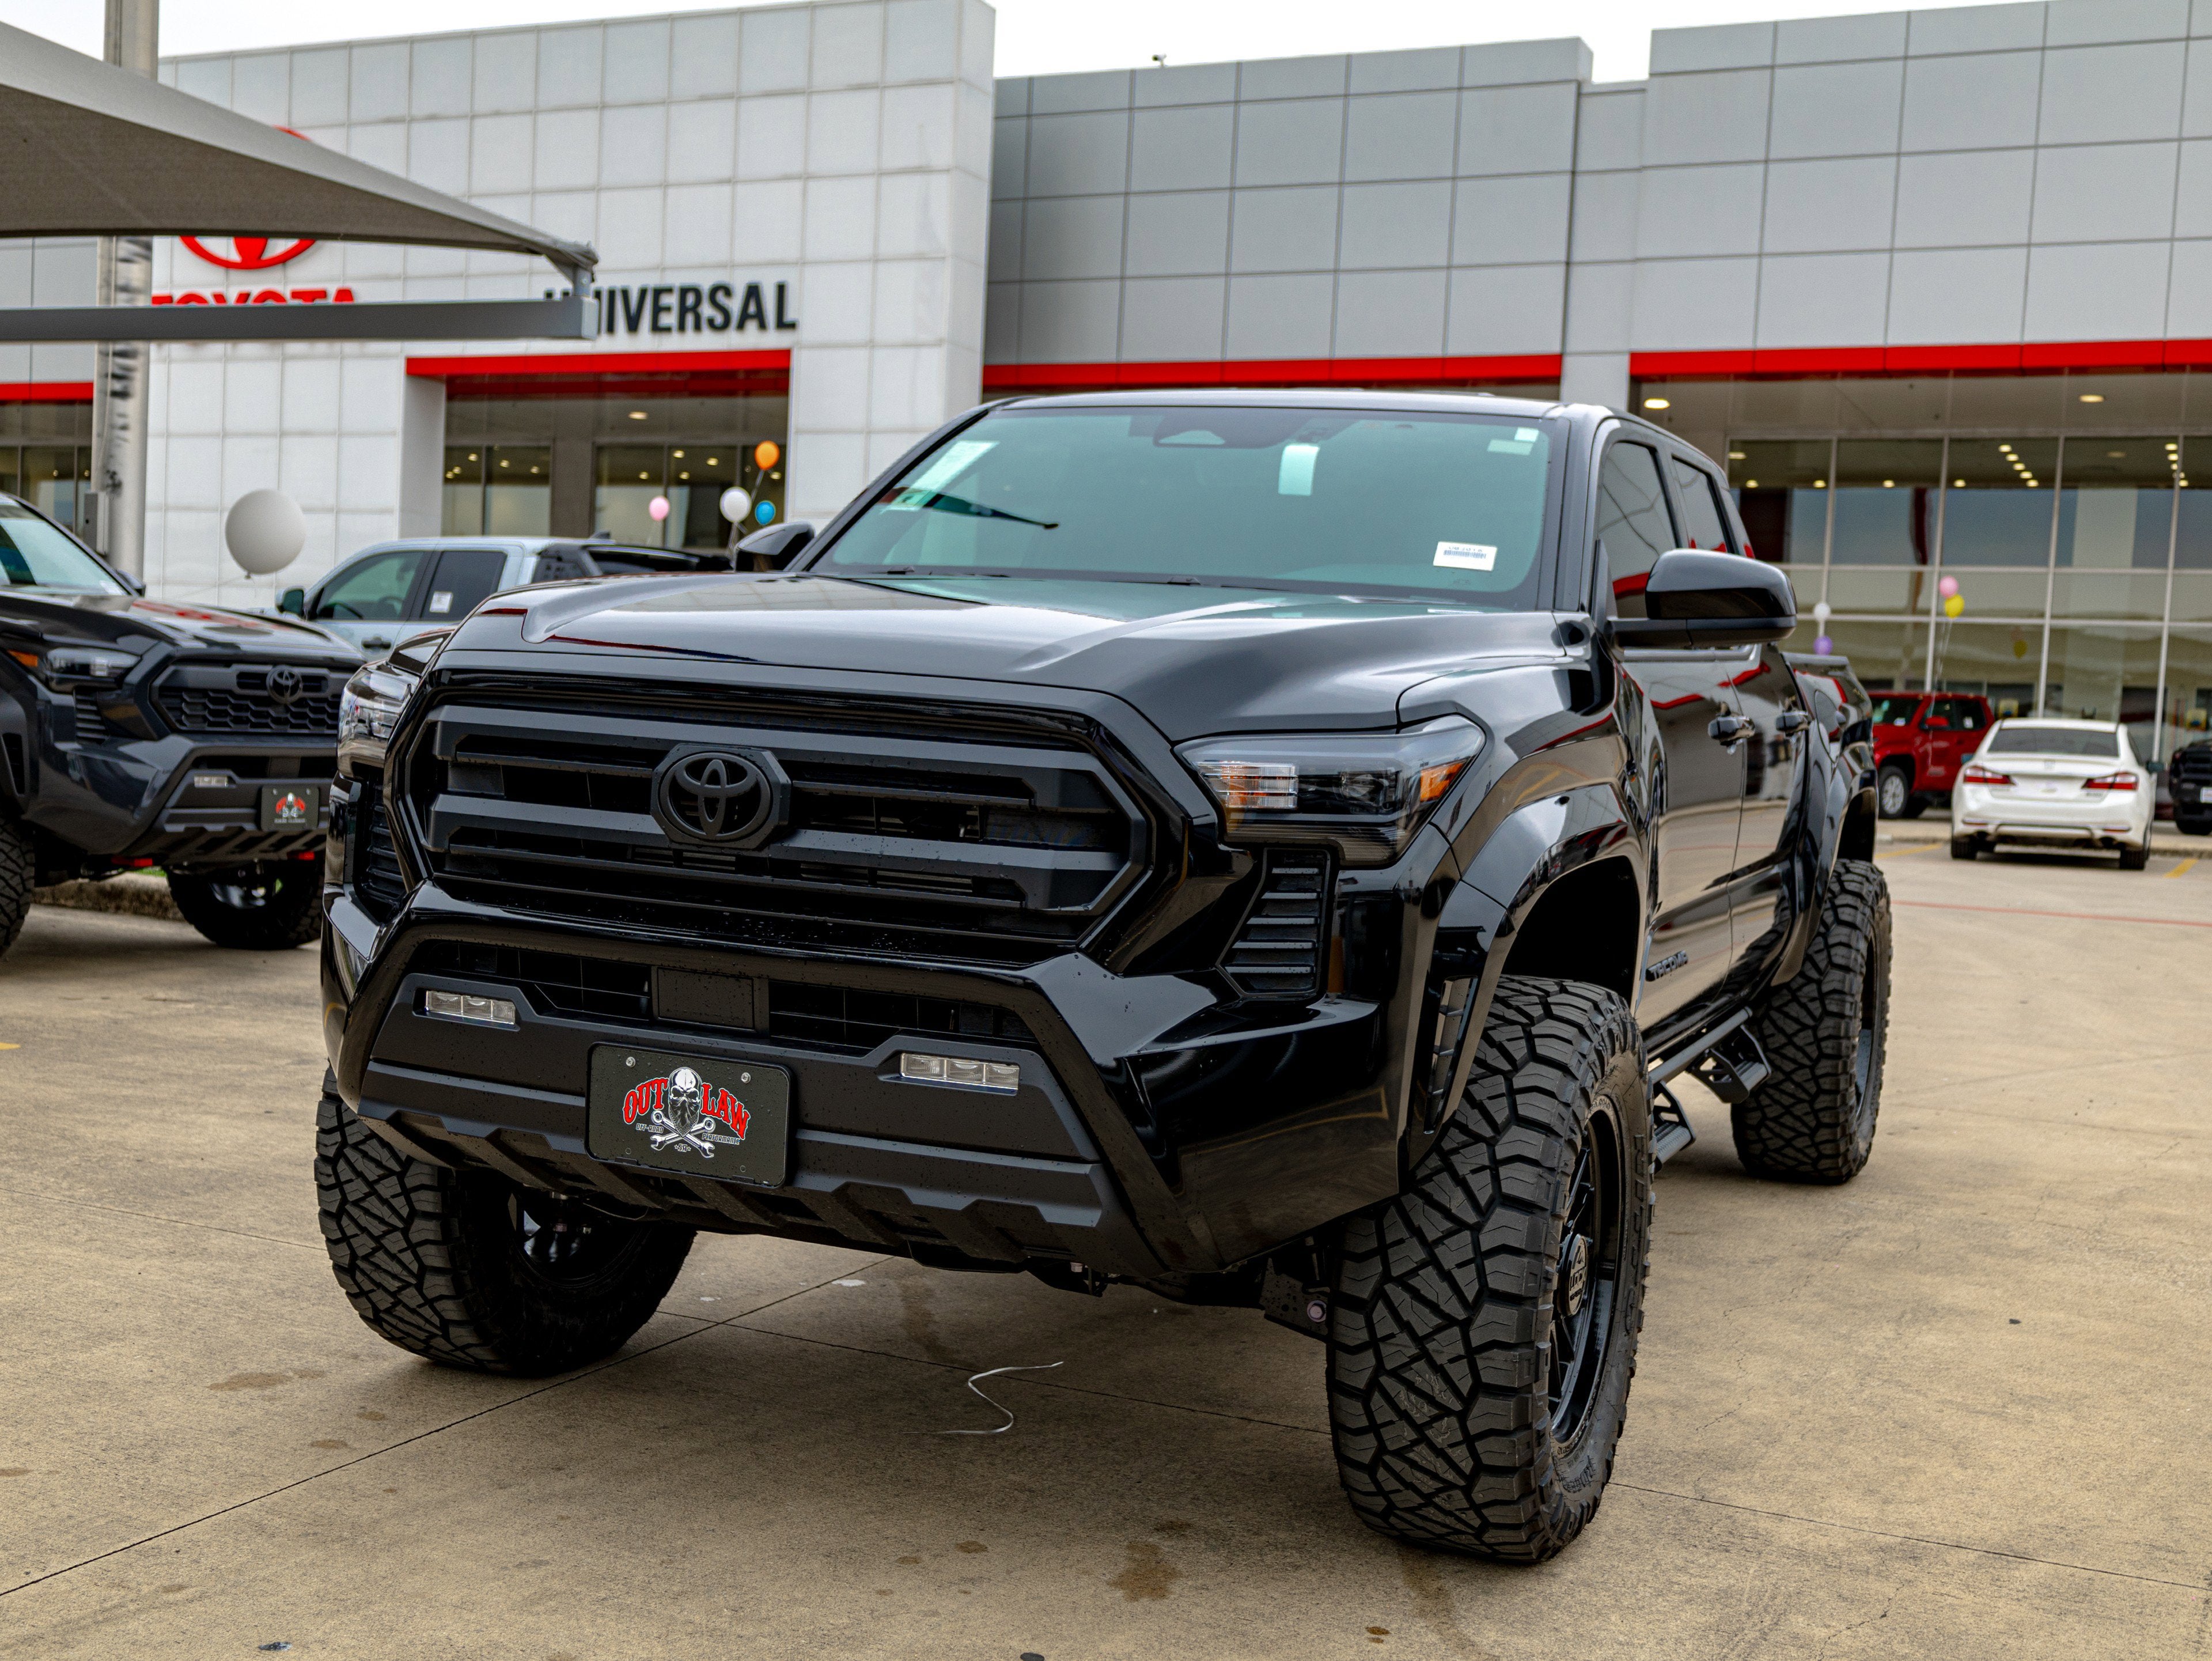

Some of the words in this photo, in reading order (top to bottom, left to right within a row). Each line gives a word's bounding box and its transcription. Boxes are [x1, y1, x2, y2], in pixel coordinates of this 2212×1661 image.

[543, 281, 797, 334] IVERSAL
[636, 1123, 664, 1133] OFF-ROAD
[702, 1133, 740, 1145] PERFORMANCE
